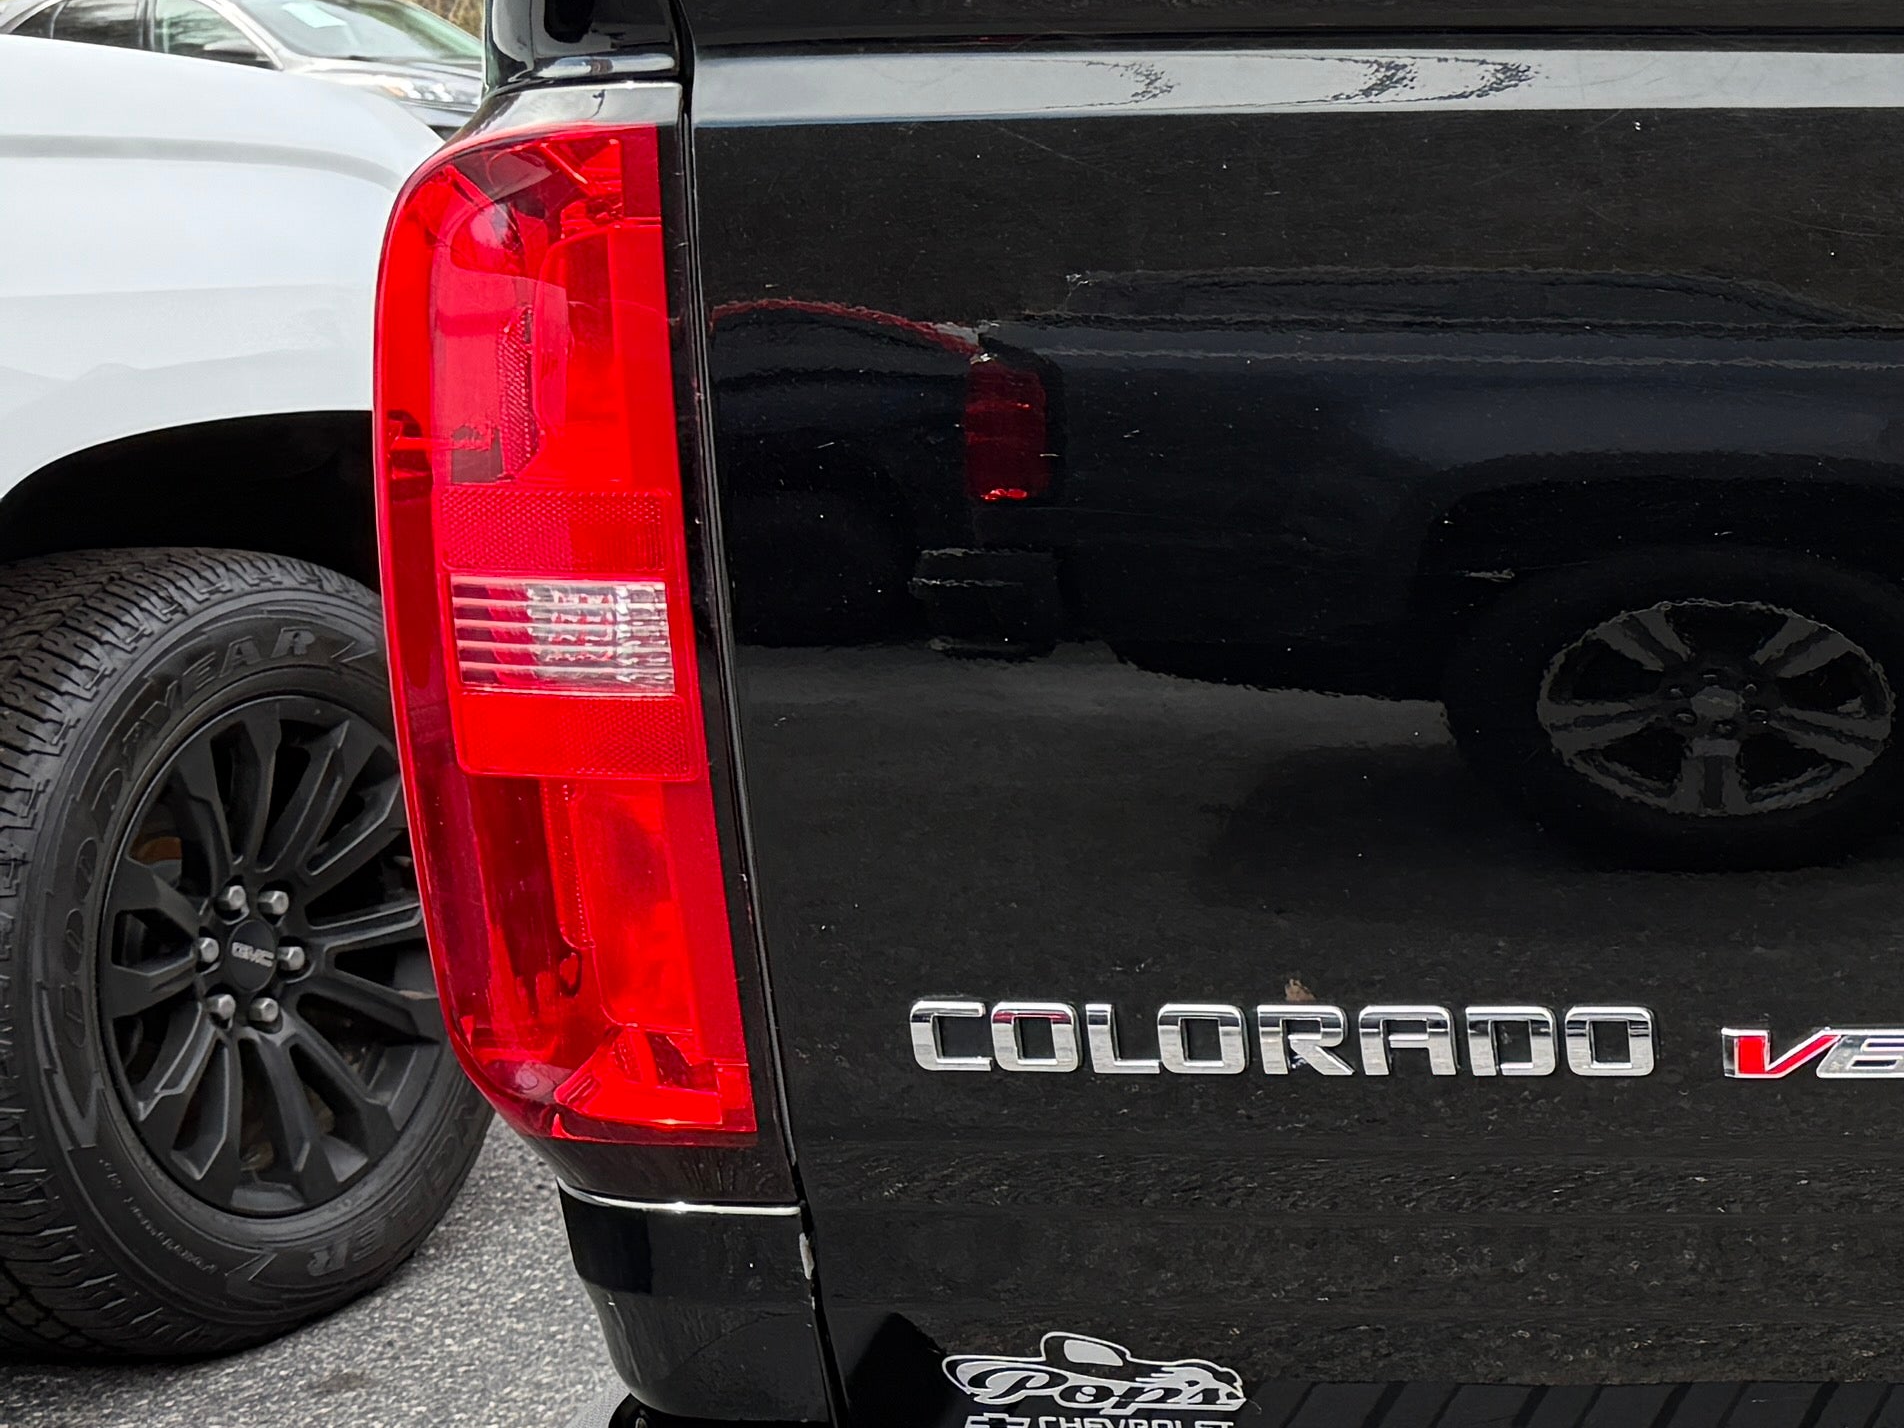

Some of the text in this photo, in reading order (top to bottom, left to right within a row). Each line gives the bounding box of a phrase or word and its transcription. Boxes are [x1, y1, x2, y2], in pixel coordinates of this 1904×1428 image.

[232, 942, 275, 967] GMC
[909, 995, 1657, 1078] COLORADO
[967, 1366, 1222, 1412] Pop's
